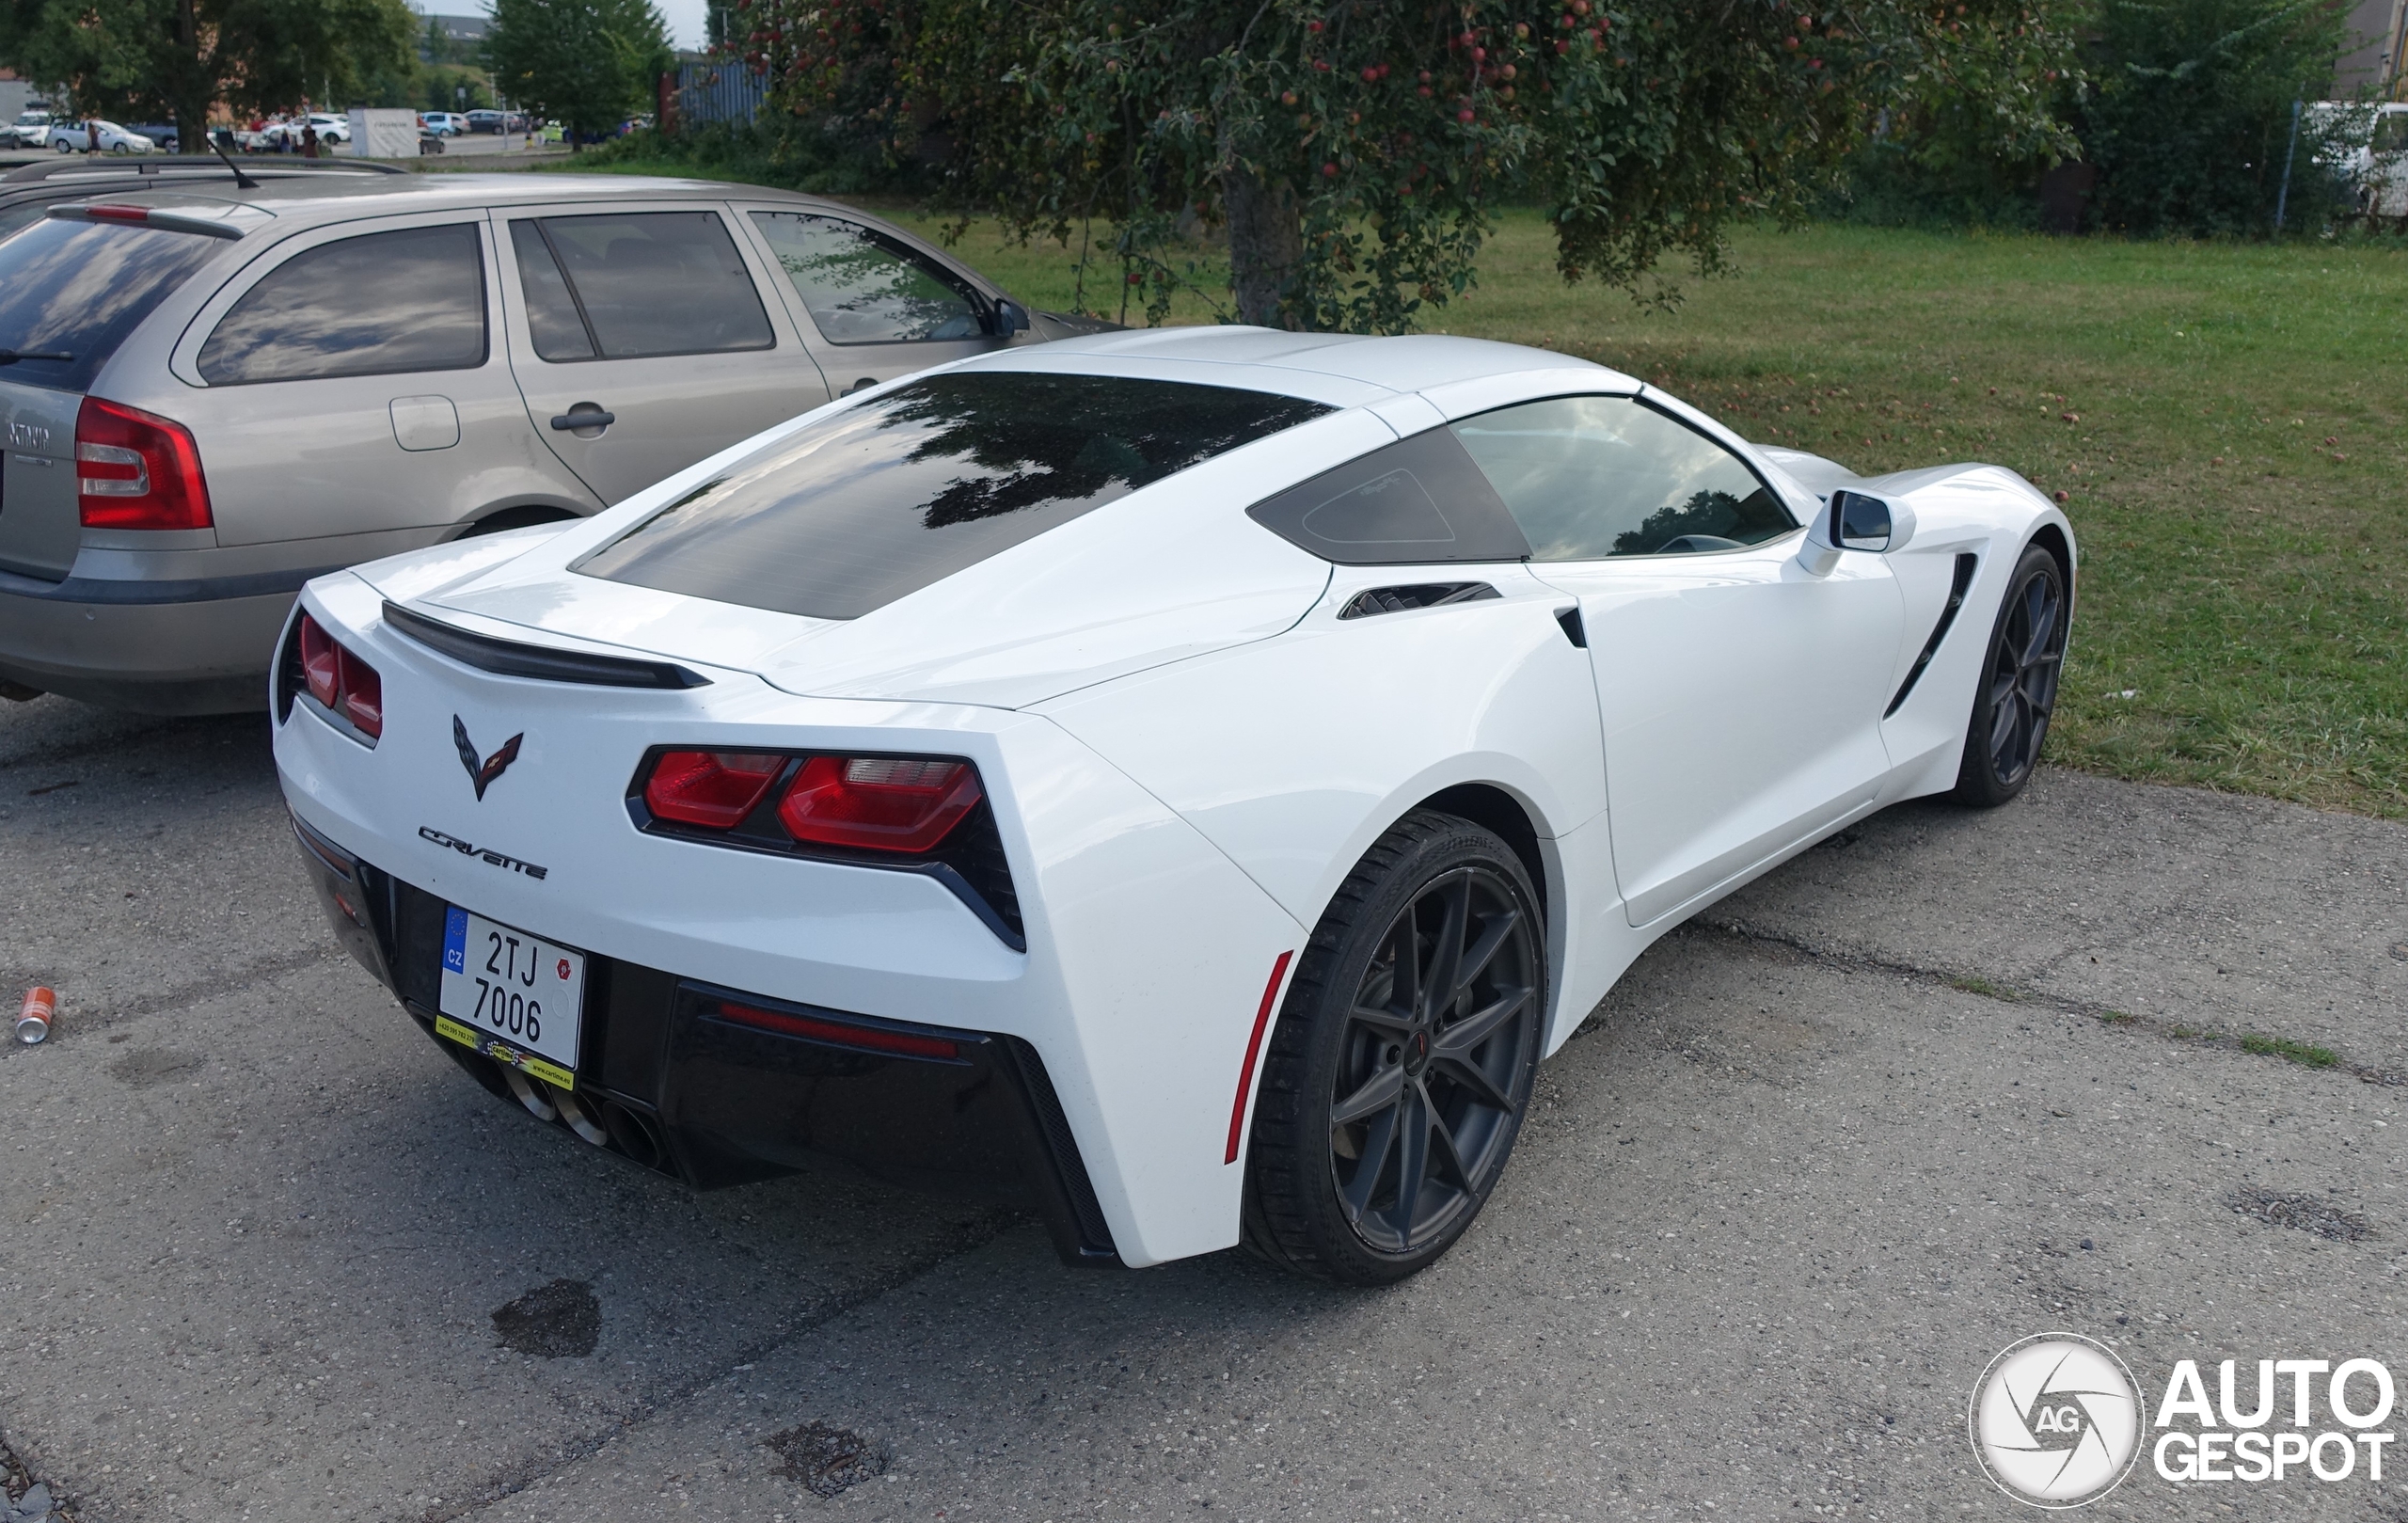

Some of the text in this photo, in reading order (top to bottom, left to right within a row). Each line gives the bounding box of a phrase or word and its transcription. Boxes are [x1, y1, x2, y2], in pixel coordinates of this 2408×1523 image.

[447, 947, 463, 967] CZ
[485, 931, 538, 987] 2TJ
[473, 977, 542, 1042] 7006
[493, 1046, 514, 1060] cartime
[533, 1064, 571, 1085] www.cartime.eu
